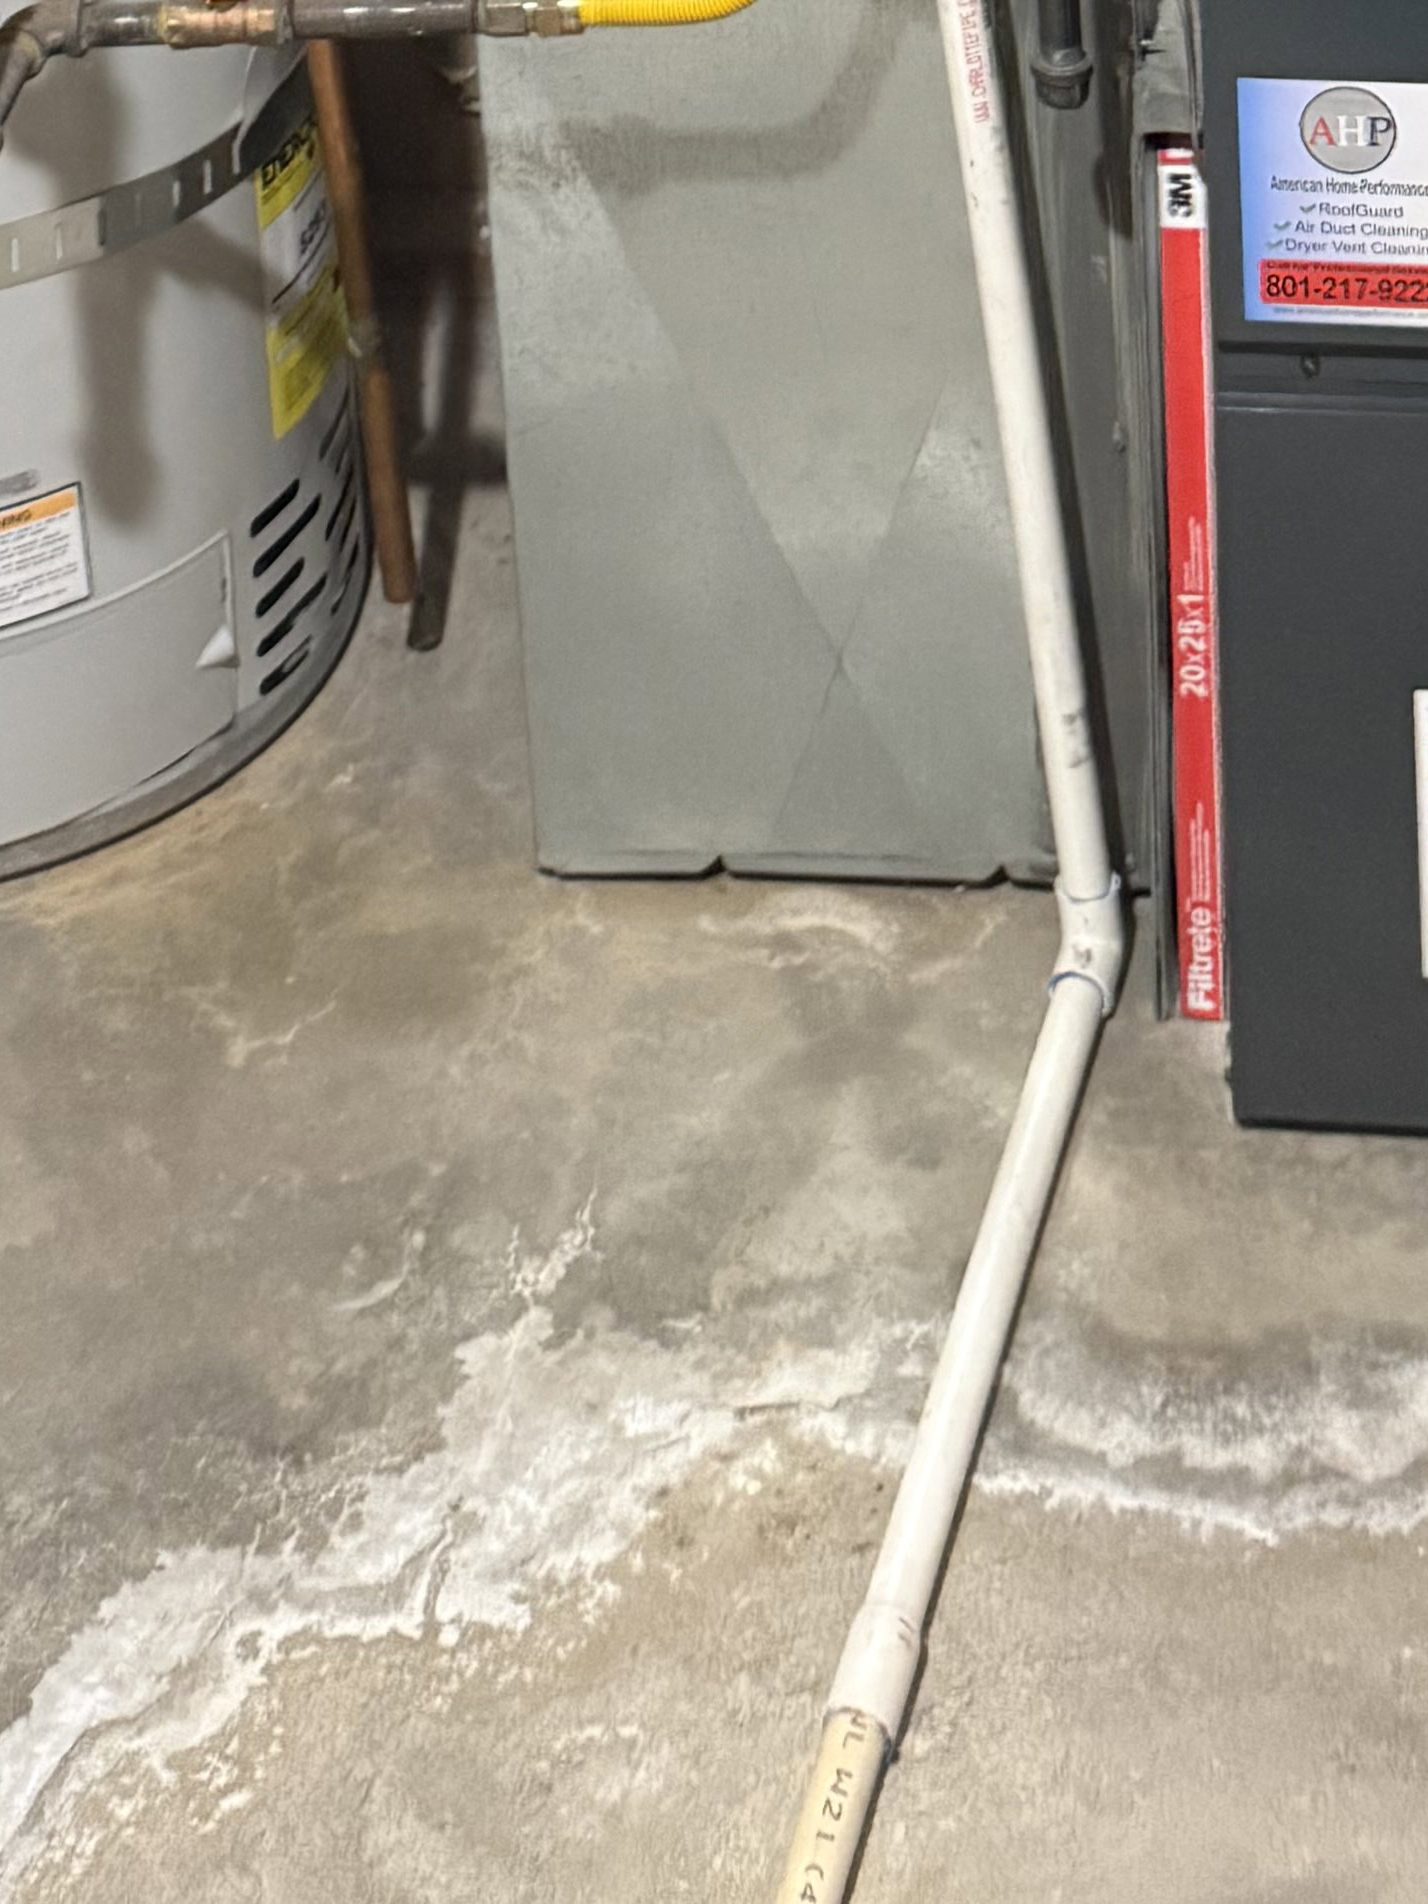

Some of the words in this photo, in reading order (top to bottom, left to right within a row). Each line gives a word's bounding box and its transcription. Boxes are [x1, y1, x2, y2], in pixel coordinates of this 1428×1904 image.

[1309, 115, 1394, 148] AHP
[1169, 173, 1193, 218] 3M
[1270, 175, 1323, 195] American
[1325, 177, 1358, 195] Home
[1295, 219, 1315, 234] Air
[1320, 221, 1357, 235] Duct
[1285, 238, 1327, 253] Dryer
[1332, 239, 1367, 254] Vent
[1185, 905, 1217, 1013] Filtrete
